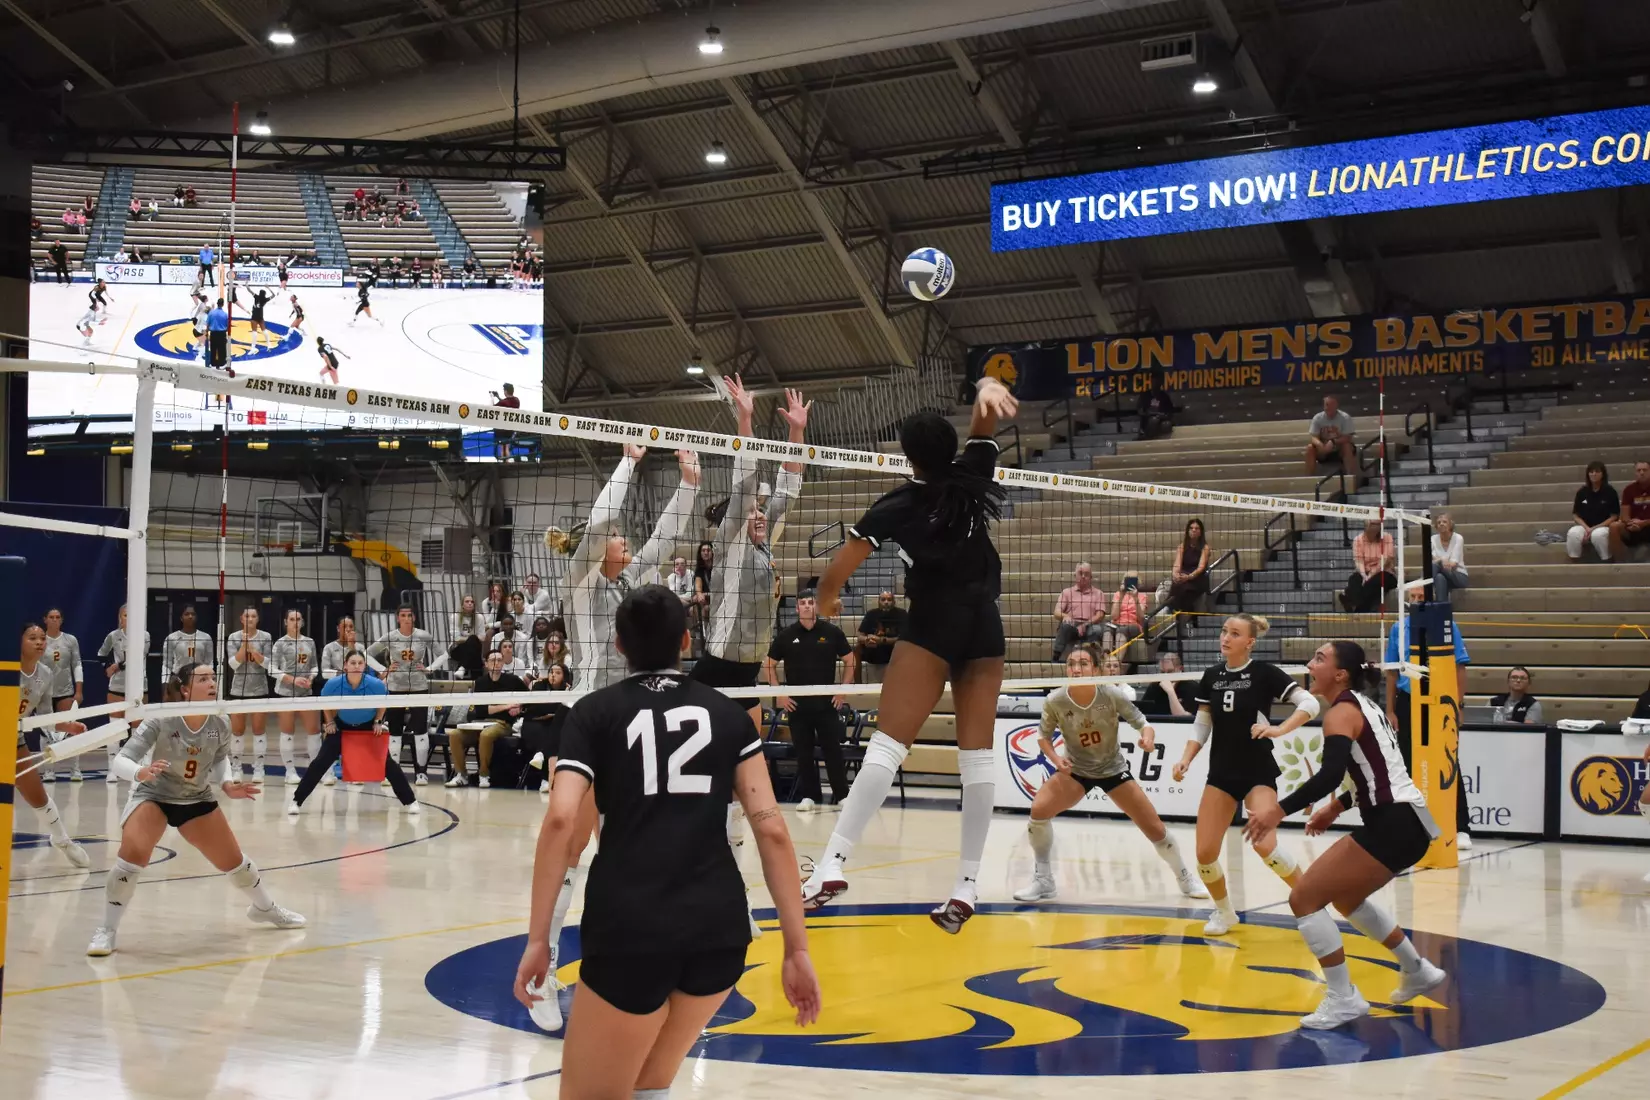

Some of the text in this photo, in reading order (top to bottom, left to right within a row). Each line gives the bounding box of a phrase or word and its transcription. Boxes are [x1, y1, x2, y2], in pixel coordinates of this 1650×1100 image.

[1003, 131, 1650, 232] BUY TICKETS NOW! LIONATHLETICS.CO
[124, 268, 144, 278] ASG
[288, 270, 341, 280] Brookshire's
[1065, 335, 1174, 374] LION
[1192, 321, 1353, 365] MEN'S
[1133, 365, 1261, 393] CHMPIONSHIPS
[1285, 363, 1295, 383] 7
[1301, 359, 1347, 382] NCAA
[1353, 350, 1484, 379] TOURNAMENTS
[1531, 345, 1555, 367] 30
[245, 378, 338, 400] EAST TEXAS A&M
[367, 394, 450, 415] EAST TEXAS A&M
[164, 411, 192, 419] Illinois
[232, 413, 243, 422] 10
[348, 416, 355, 424] 9
[477, 409, 551, 426] EAST TEXAS A&M
[576, 420, 644, 437] EAST TEXAS A&M
[665, 431, 727, 448] EAST TEXAS A&M
[746, 442, 803, 456] EAST TEXAS A&M
[820, 450, 873, 463] EAST TEXAS A&M
[889, 457, 904, 467] EAST
[53, 651, 60, 661] 2
[297, 654, 308, 664] 12
[401, 650, 414, 661] 22
[19, 699, 29, 714] 6
[1223, 690, 1235, 712] 9
[1079, 731, 1101, 748] 20
[626, 705, 713, 796] 12
[184, 760, 197, 779] 9
[1470, 806, 1512, 826] are
